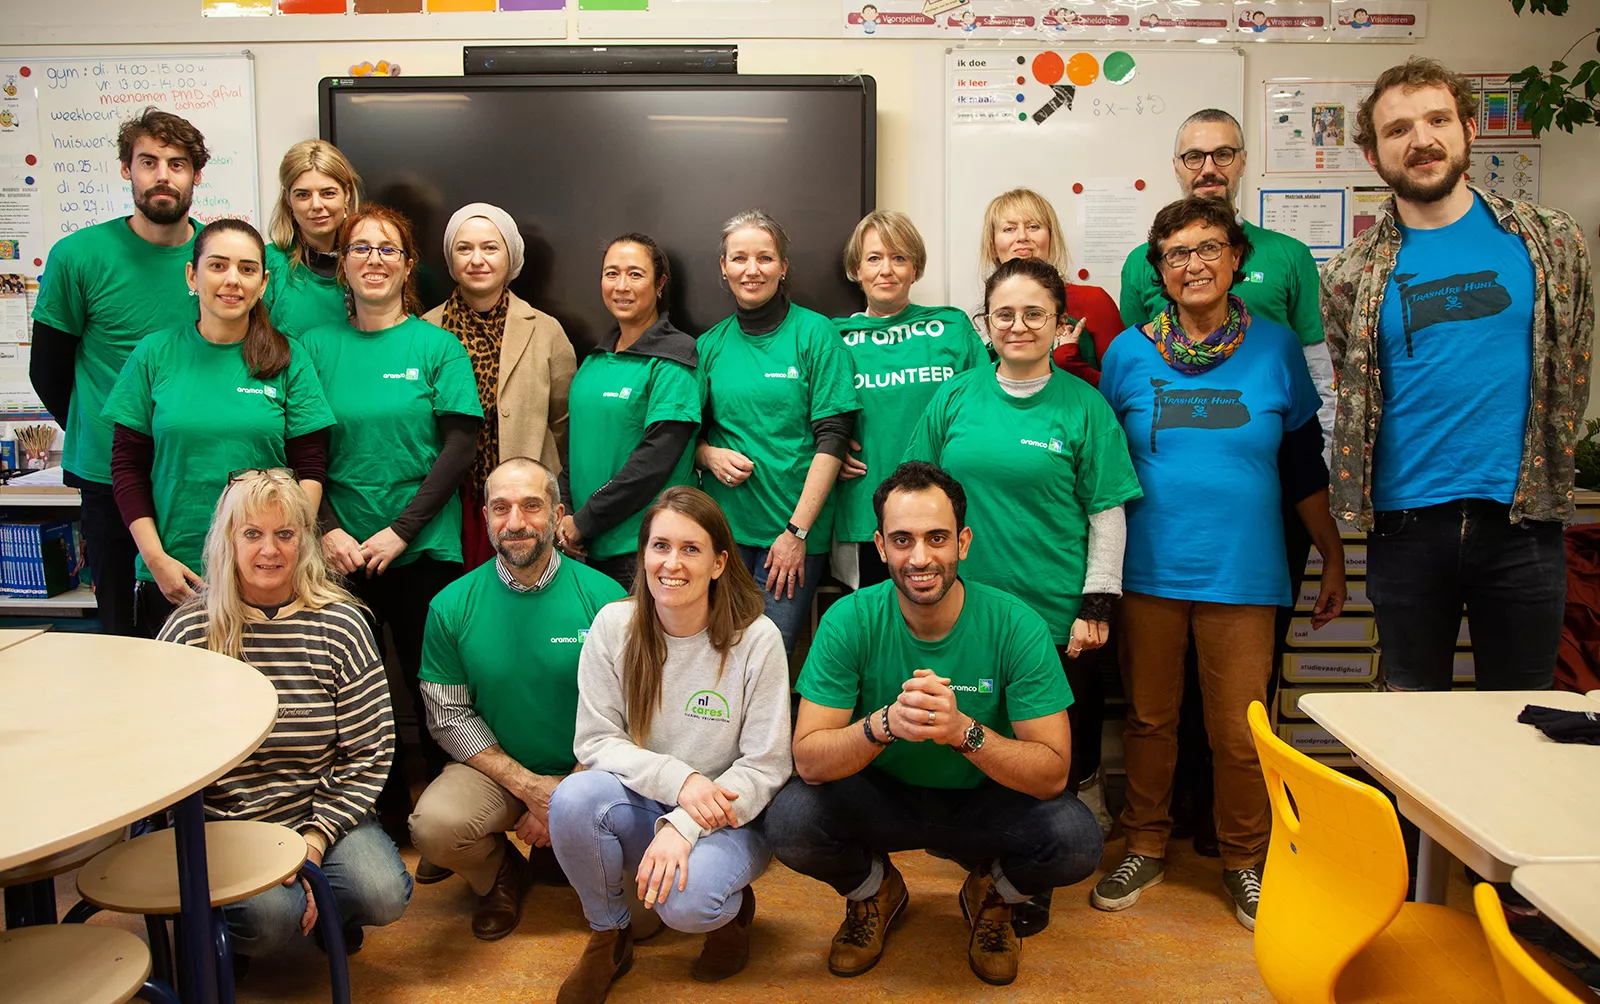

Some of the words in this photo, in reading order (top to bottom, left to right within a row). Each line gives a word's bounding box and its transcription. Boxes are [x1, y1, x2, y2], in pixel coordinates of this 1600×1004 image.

[883, 15, 925, 24] Voorspellen
[1270, 18, 1292, 27] Vragen
[1370, 15, 1408, 23] Visualiseren
[957, 59, 966, 67] ik
[969, 59, 987, 67] doe
[957, 79, 966, 87] ik
[969, 79, 988, 87] leer
[843, 319, 945, 347] aramco
[854, 366, 955, 389] OLUNTEER
[236, 386, 264, 395] aramco
[1020, 438, 1048, 449] aramco
[1300, 664, 1362, 673] studievaardigheid
[698, 695, 709, 706] nl
[691, 705, 723, 717] cares
